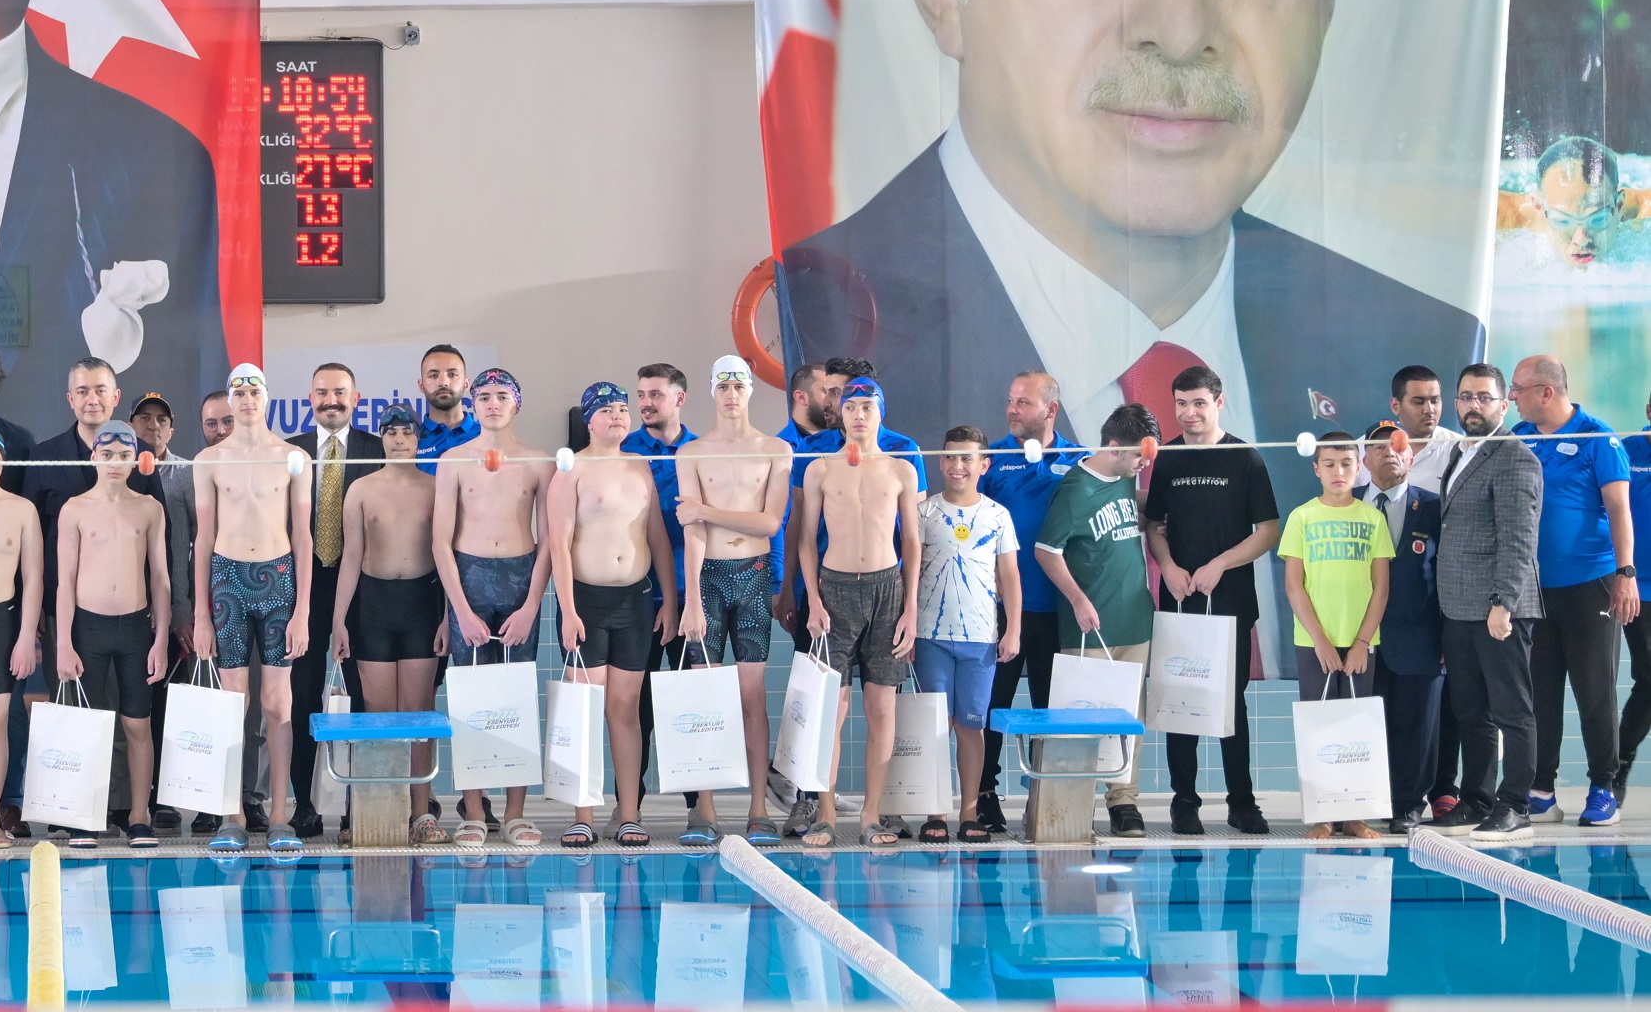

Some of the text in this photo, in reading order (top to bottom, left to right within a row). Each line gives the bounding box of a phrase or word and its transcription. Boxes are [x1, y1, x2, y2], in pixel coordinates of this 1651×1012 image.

[276, 61, 317, 73] SAAT
[999, 464, 1026, 472] uhlsport
[1088, 501, 1122, 542] LONG
[1304, 520, 1376, 542] KITESURF
[1309, 541, 1372, 564] ACADEMY
